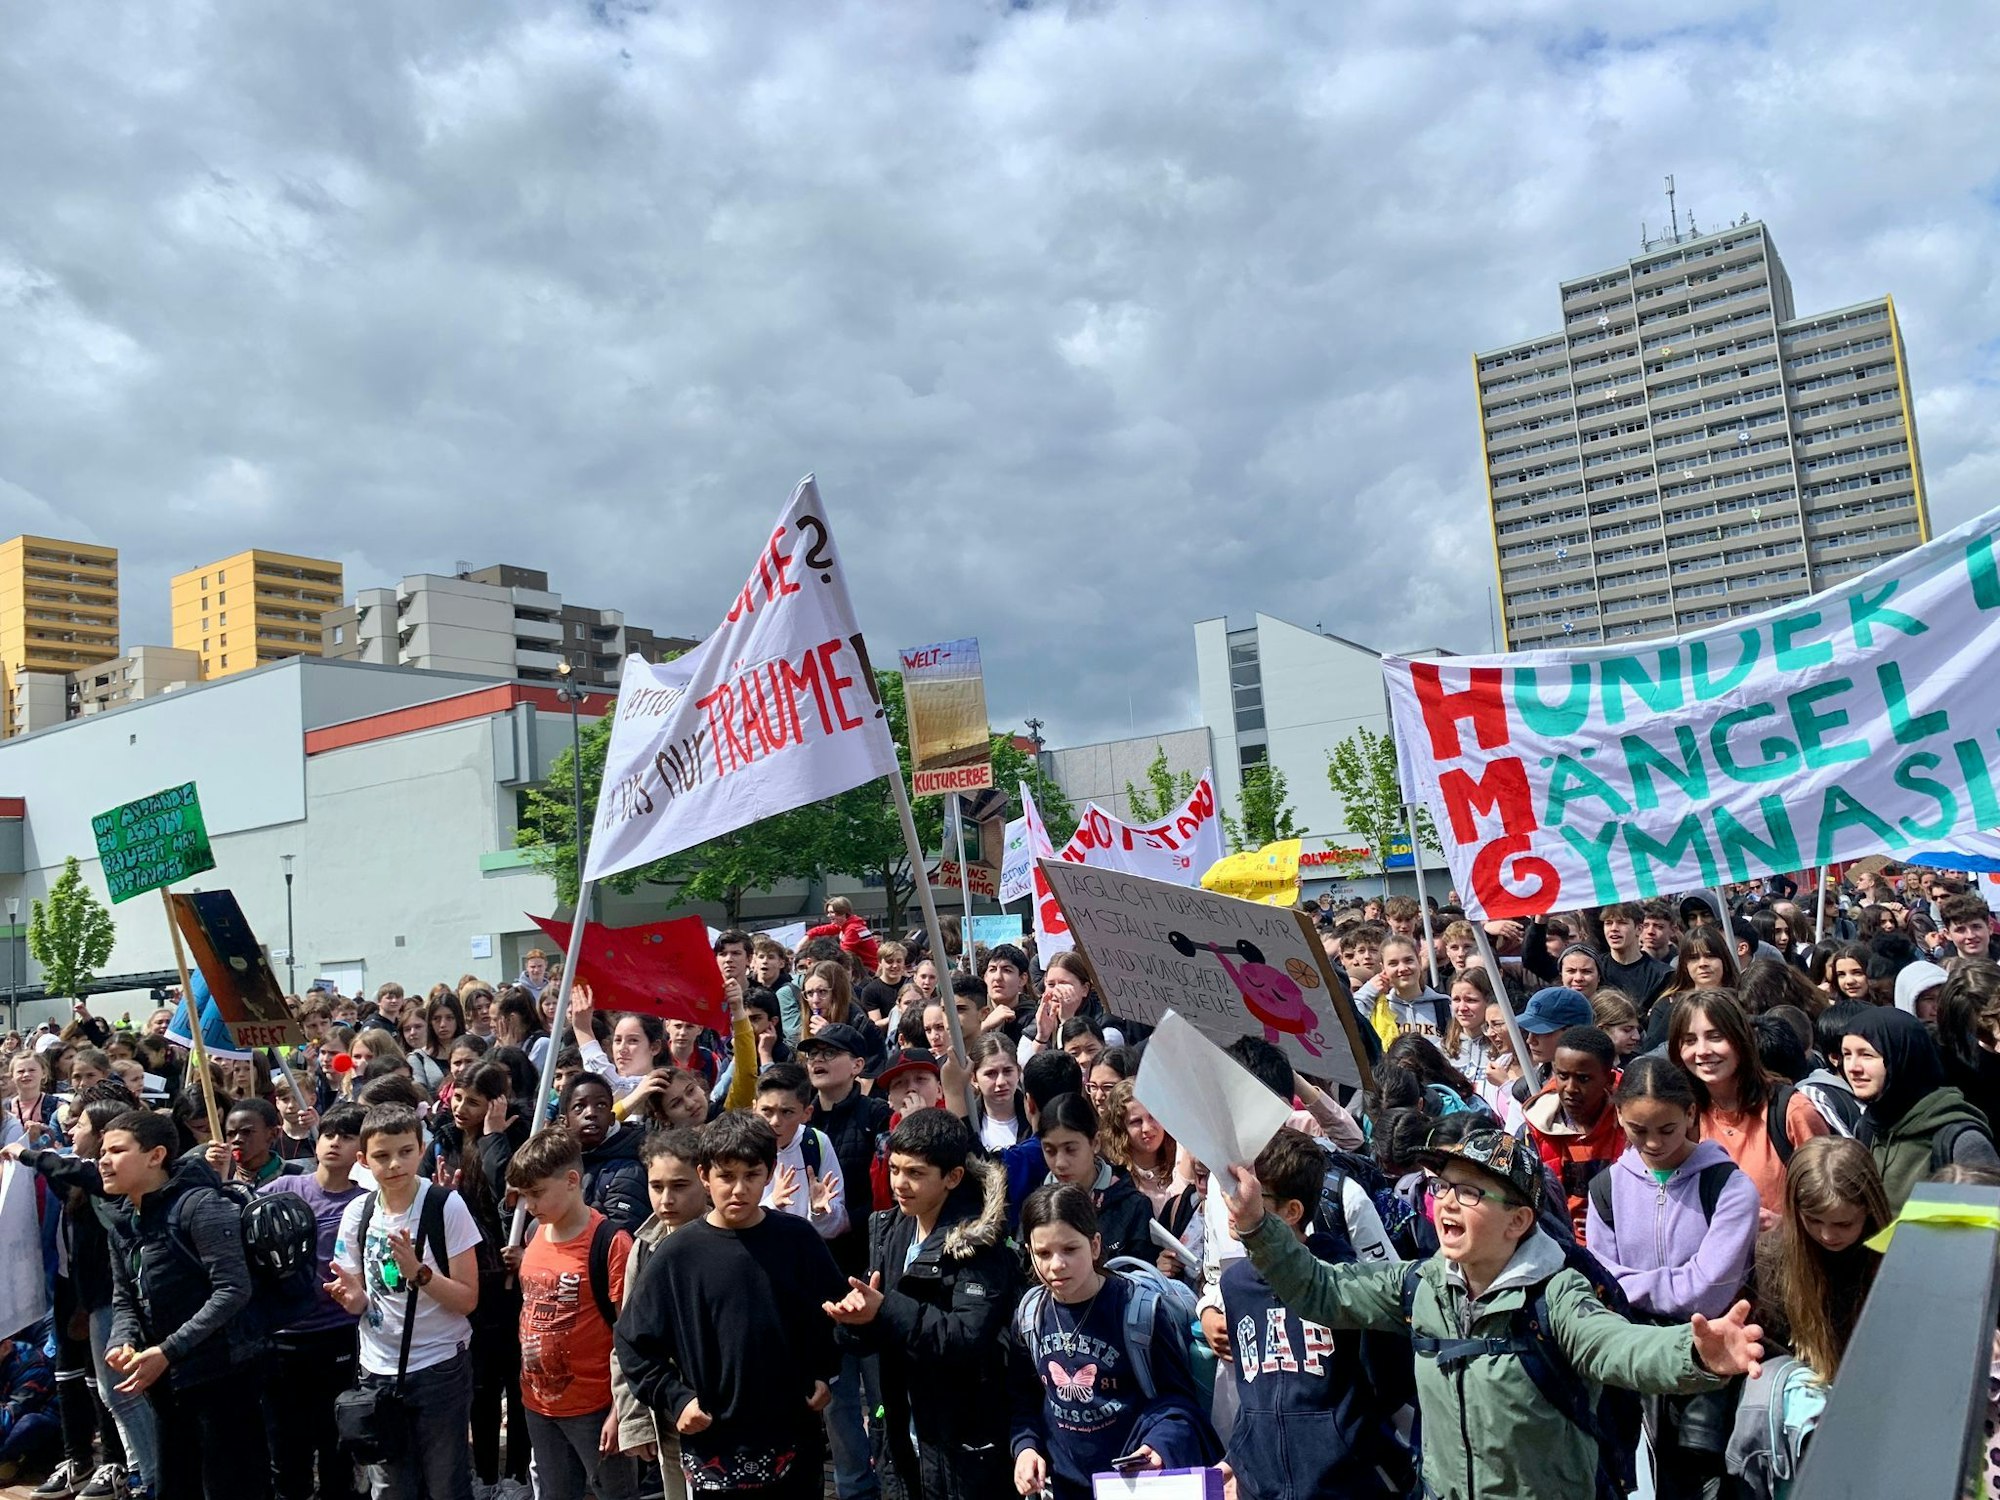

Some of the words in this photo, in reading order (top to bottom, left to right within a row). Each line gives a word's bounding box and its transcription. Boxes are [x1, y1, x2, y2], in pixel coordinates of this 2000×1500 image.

[1439, 661, 1949, 845] MÄNGEL
[913, 765, 990, 795] KULTURERBE
[93, 815, 115, 836] UM
[1471, 728, 2000, 920] GYMNASI
[97, 830, 118, 853] ZU
[1070, 905, 1098, 932] IM
[1098, 909, 1171, 945] STALLE
[1160, 891, 1242, 929] TURNEN
[1246, 911, 1299, 944] WIR
[1088, 945, 1136, 971] UND
[1134, 953, 1230, 995] WÜNSCHEN
[1182, 990, 1240, 1019] NEUE
[237, 1025, 287, 1046] DEFEKT
[557, 1271, 581, 1303] NYC
[1236, 1309, 1335, 1384] GAP
[1101, 1371, 1118, 1390] 81
[1081, 1400, 1123, 1423] CLUB
